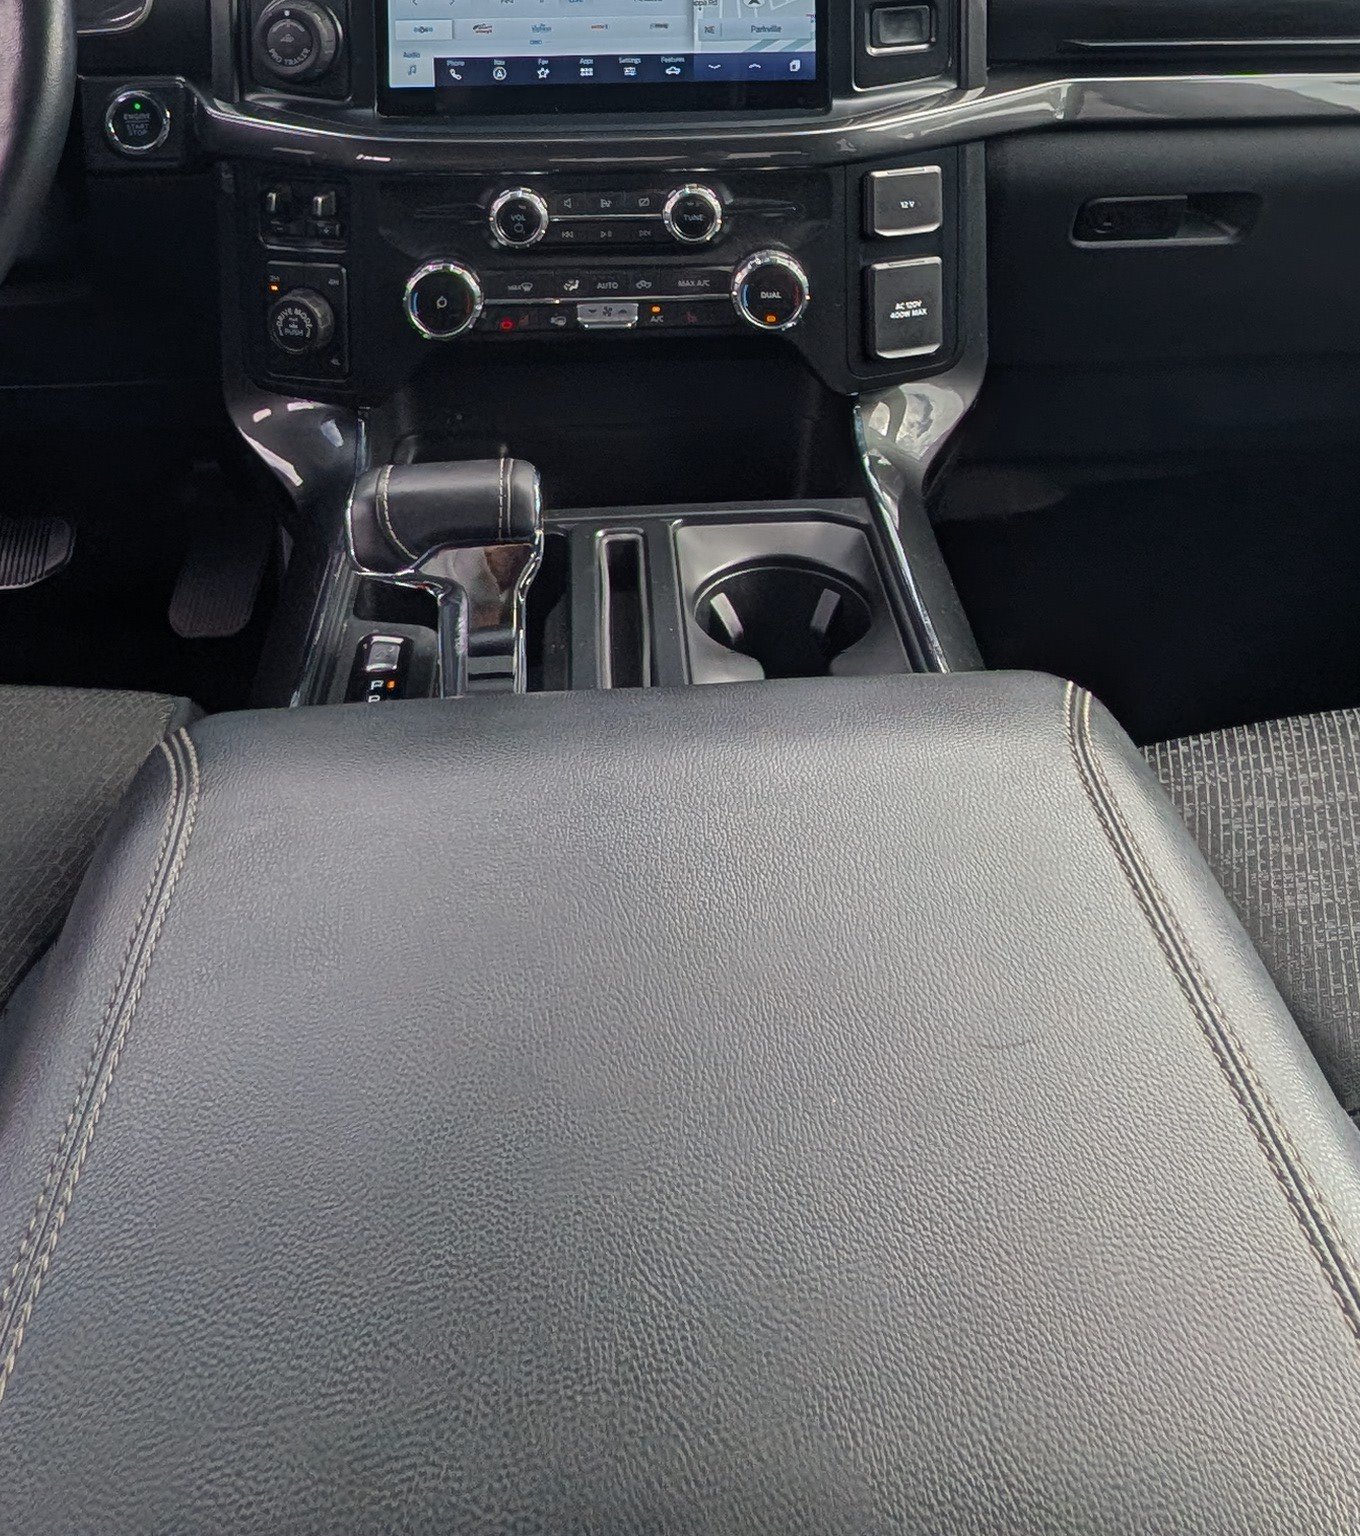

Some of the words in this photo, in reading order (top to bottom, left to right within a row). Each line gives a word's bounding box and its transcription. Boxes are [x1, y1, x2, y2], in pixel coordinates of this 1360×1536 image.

[751, 25, 782, 33] Parkville
[403, 51, 420, 59] Audio
[596, 282, 619, 290] AUTO
[678, 280, 695, 288] MAX
[696, 279, 710, 287] A/C
[760, 291, 782, 299] DUAL
[911, 308, 928, 318] MAX
[650, 315, 664, 323] A/C
[370, 679, 384, 691] P
